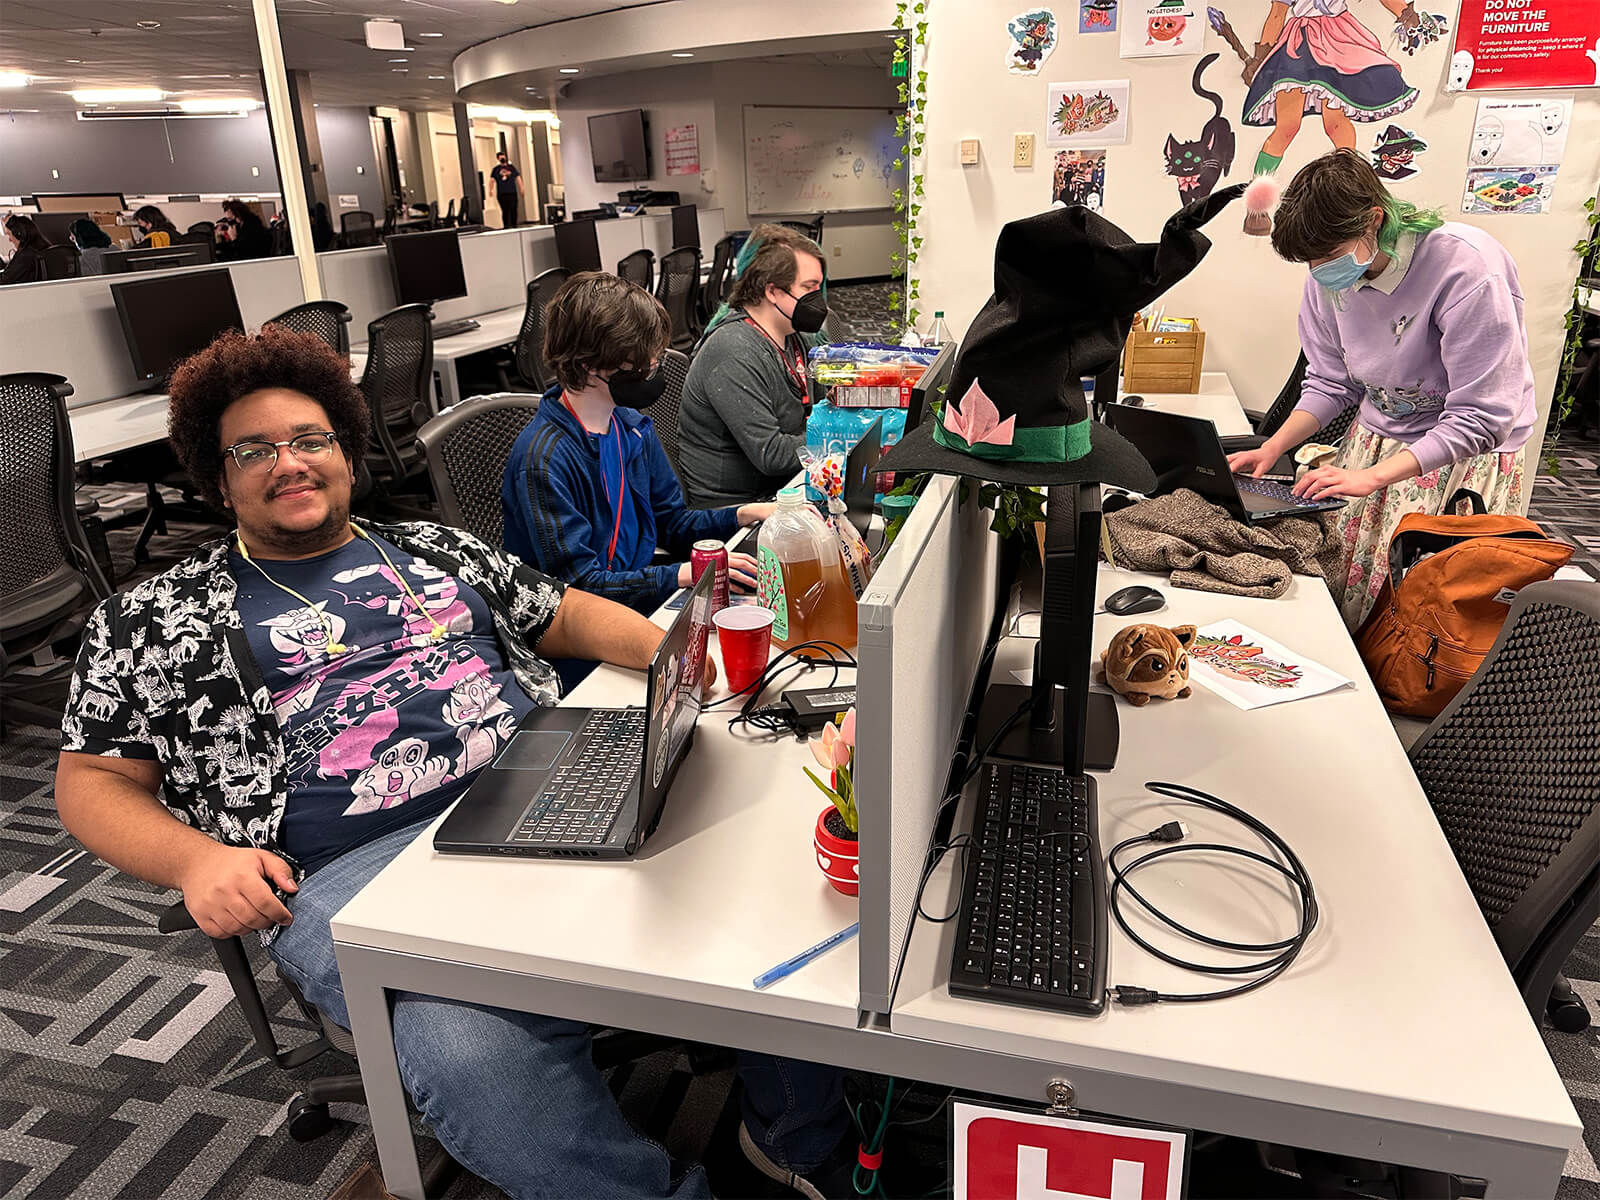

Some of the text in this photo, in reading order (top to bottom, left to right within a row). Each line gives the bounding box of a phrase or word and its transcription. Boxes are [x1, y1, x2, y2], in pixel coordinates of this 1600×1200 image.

[1485, 0, 1532, 10] DO NOT
[1483, 10, 1546, 22] MOVE THE
[1481, 22, 1550, 34] FURNITURE
[1486, 46, 1508, 54] physical
[1509, 44, 1537, 52] distancing
[823, 438, 858, 457] ICE
[849, 561, 865, 598] WHITE
